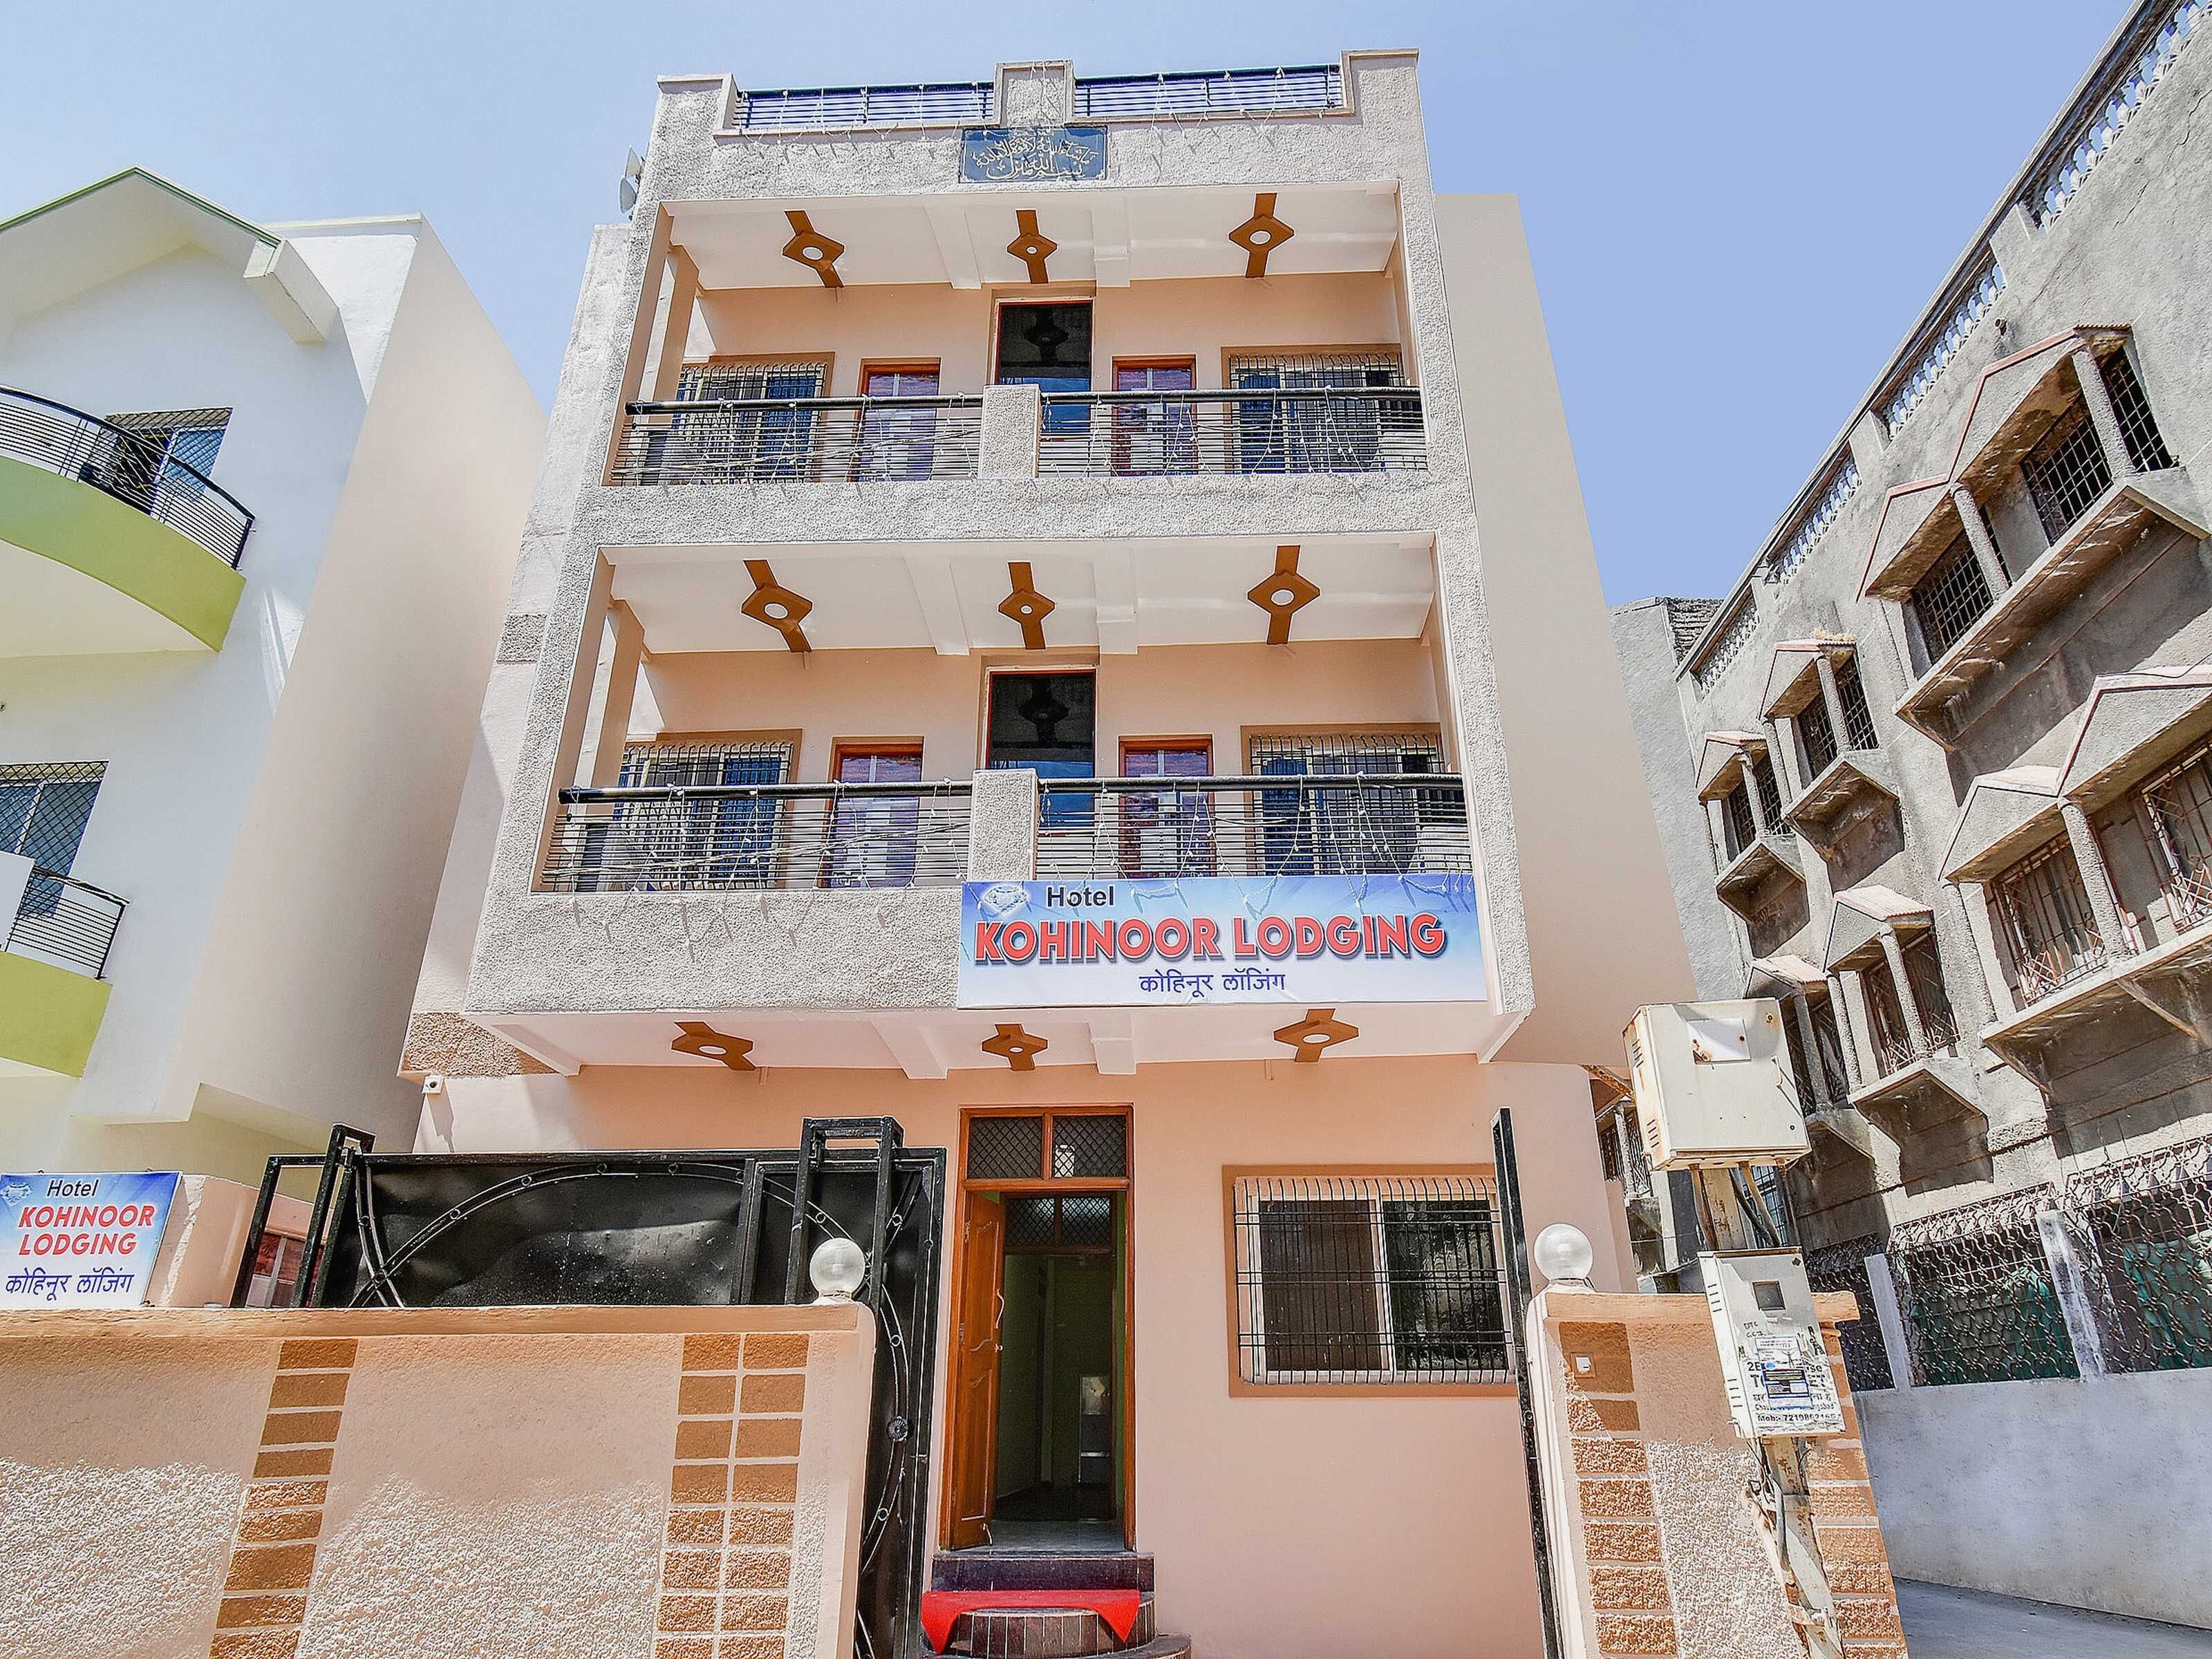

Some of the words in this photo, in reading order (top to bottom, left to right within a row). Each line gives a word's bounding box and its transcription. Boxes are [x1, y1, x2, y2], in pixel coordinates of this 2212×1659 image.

[1047, 885, 1114, 907] Hotel
[975, 916, 1222, 962] KOHINOOR
[1234, 914, 1447, 959] LODGING
[1139, 968, 1213, 997] कोहिनूर
[1222, 966, 1286, 991] लॉजिंग
[47, 1179, 99, 1197] Hotel
[19, 1206, 156, 1227] KOHINOOR
[19, 1232, 137, 1255] LODGING
[6, 1267, 72, 1301] कोहिनूर
[76, 1267, 135, 1293] लॉजिंग
